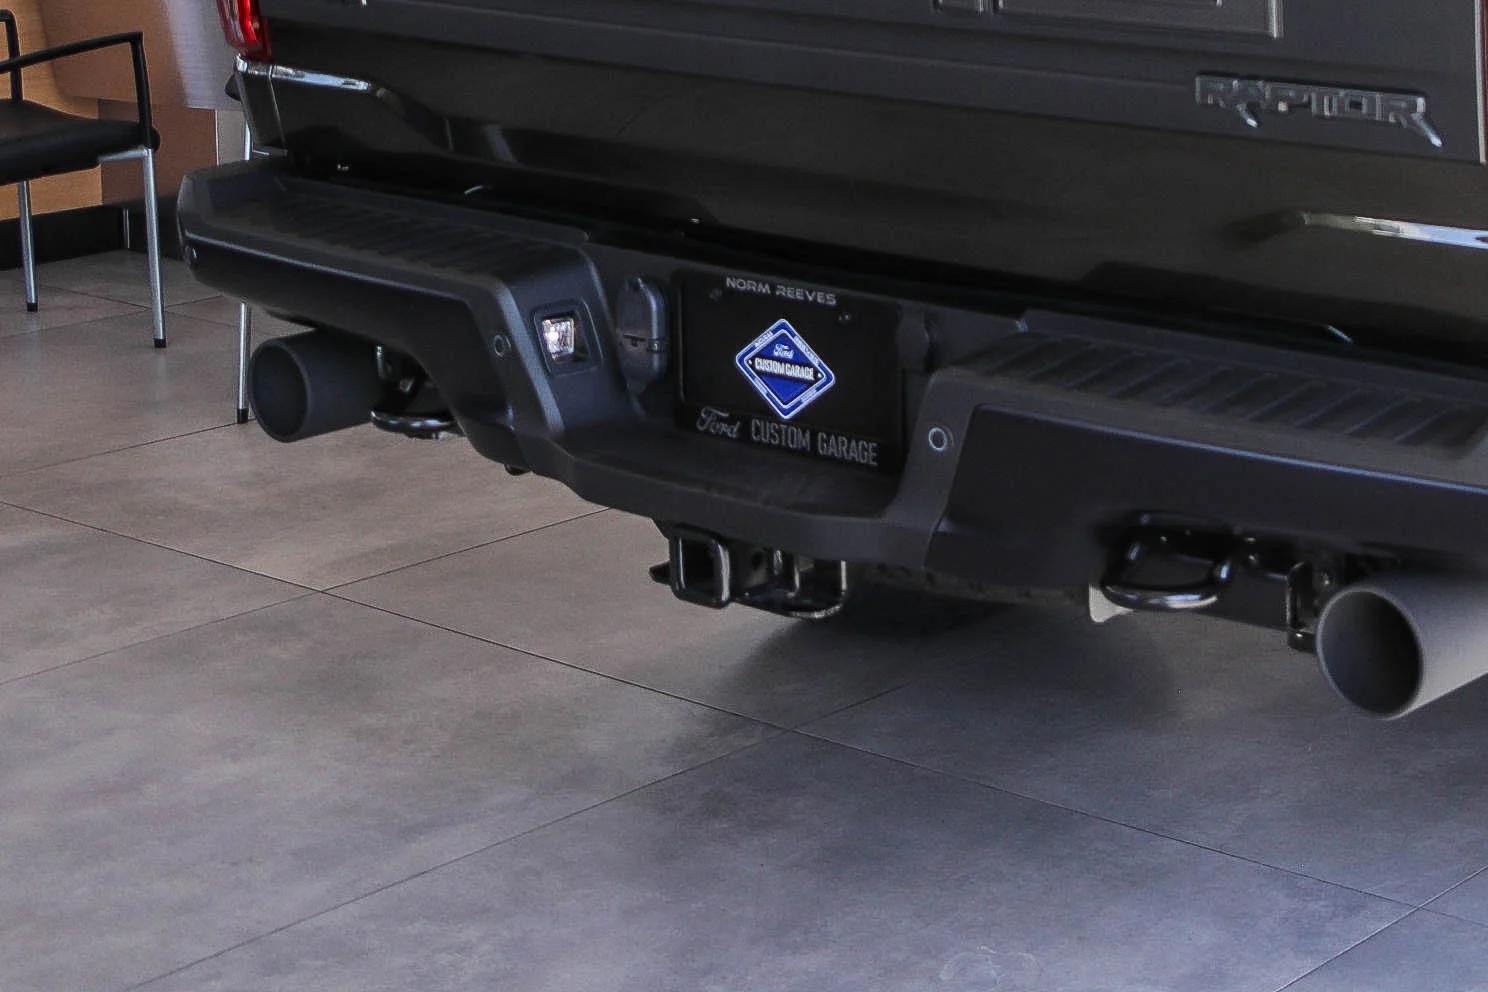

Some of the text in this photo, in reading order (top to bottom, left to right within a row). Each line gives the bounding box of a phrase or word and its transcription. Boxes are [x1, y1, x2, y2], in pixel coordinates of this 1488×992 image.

[726, 276, 837, 306] NORM REEVES
[773, 343, 795, 359] Ford
[754, 357, 815, 381] CUSTOM GARAGE
[696, 407, 879, 466] Ford CUSTOM GARAGE
